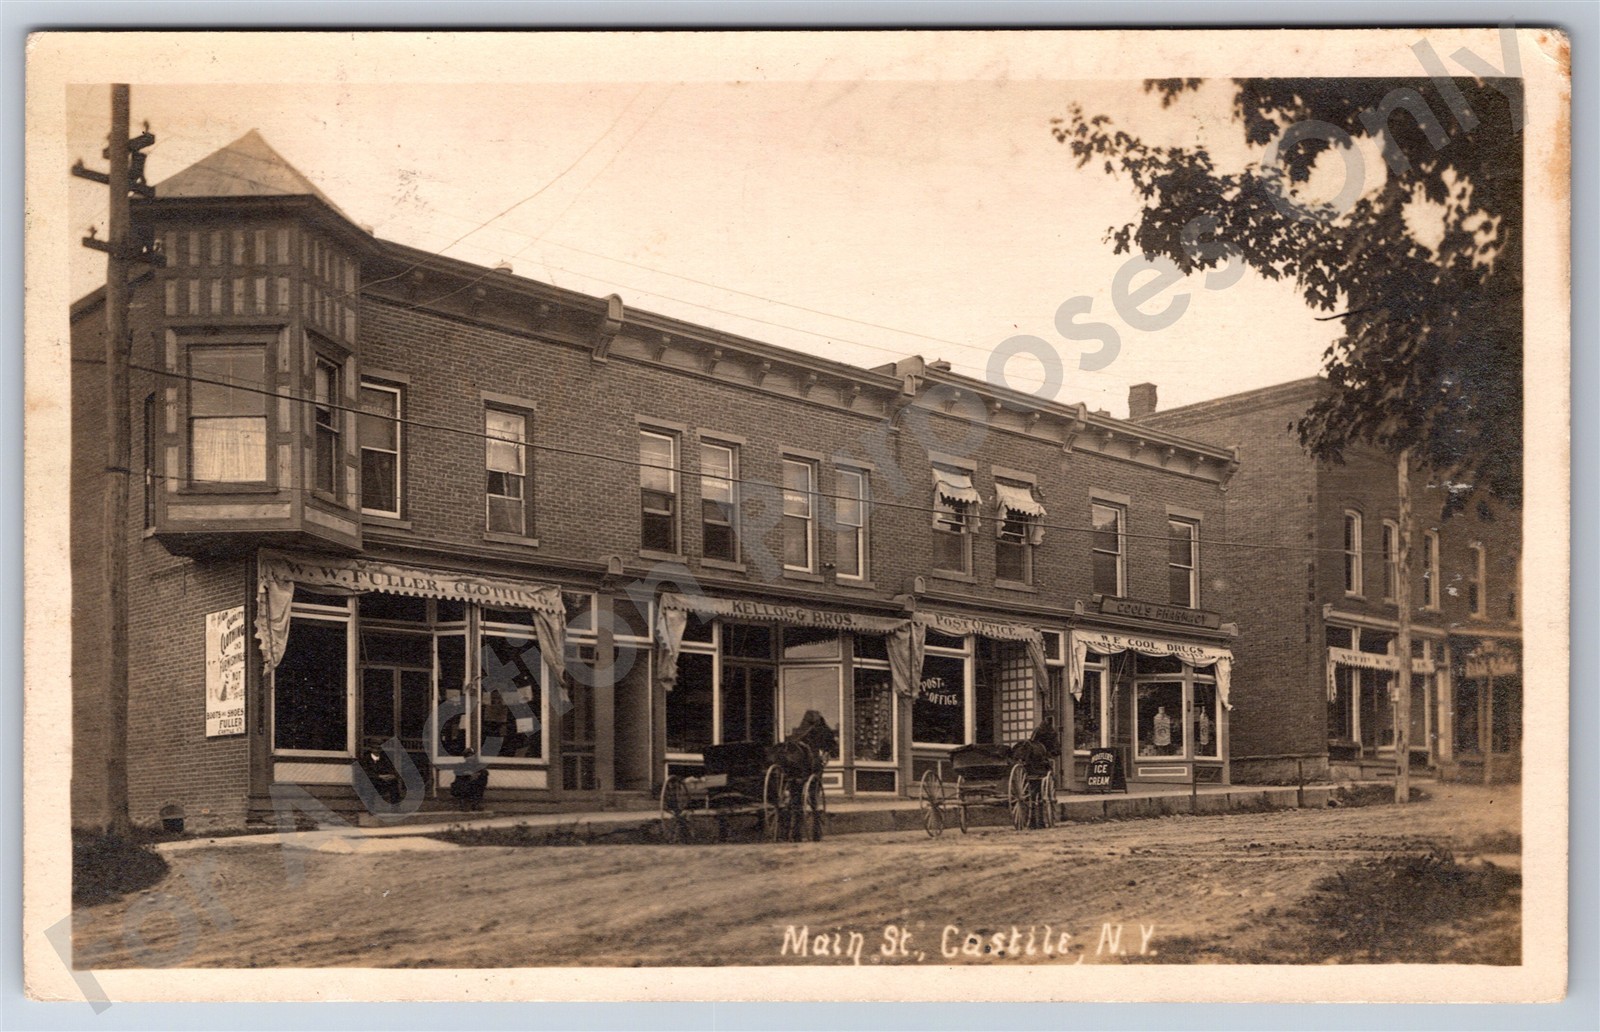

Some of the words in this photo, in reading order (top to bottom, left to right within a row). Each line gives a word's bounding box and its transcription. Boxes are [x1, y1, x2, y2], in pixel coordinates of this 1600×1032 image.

[732, 600, 805, 621] KELLOGG
[812, 611, 857, 626] BROS.
[1167, 643, 1204, 655] DRUGS
[921, 677, 942, 691] POST
[929, 692, 957, 706] OFFICE
[219, 717, 243, 729] FULLER
[1094, 764, 1108, 774] ICE
[1088, 776, 1110, 786] CREAM
